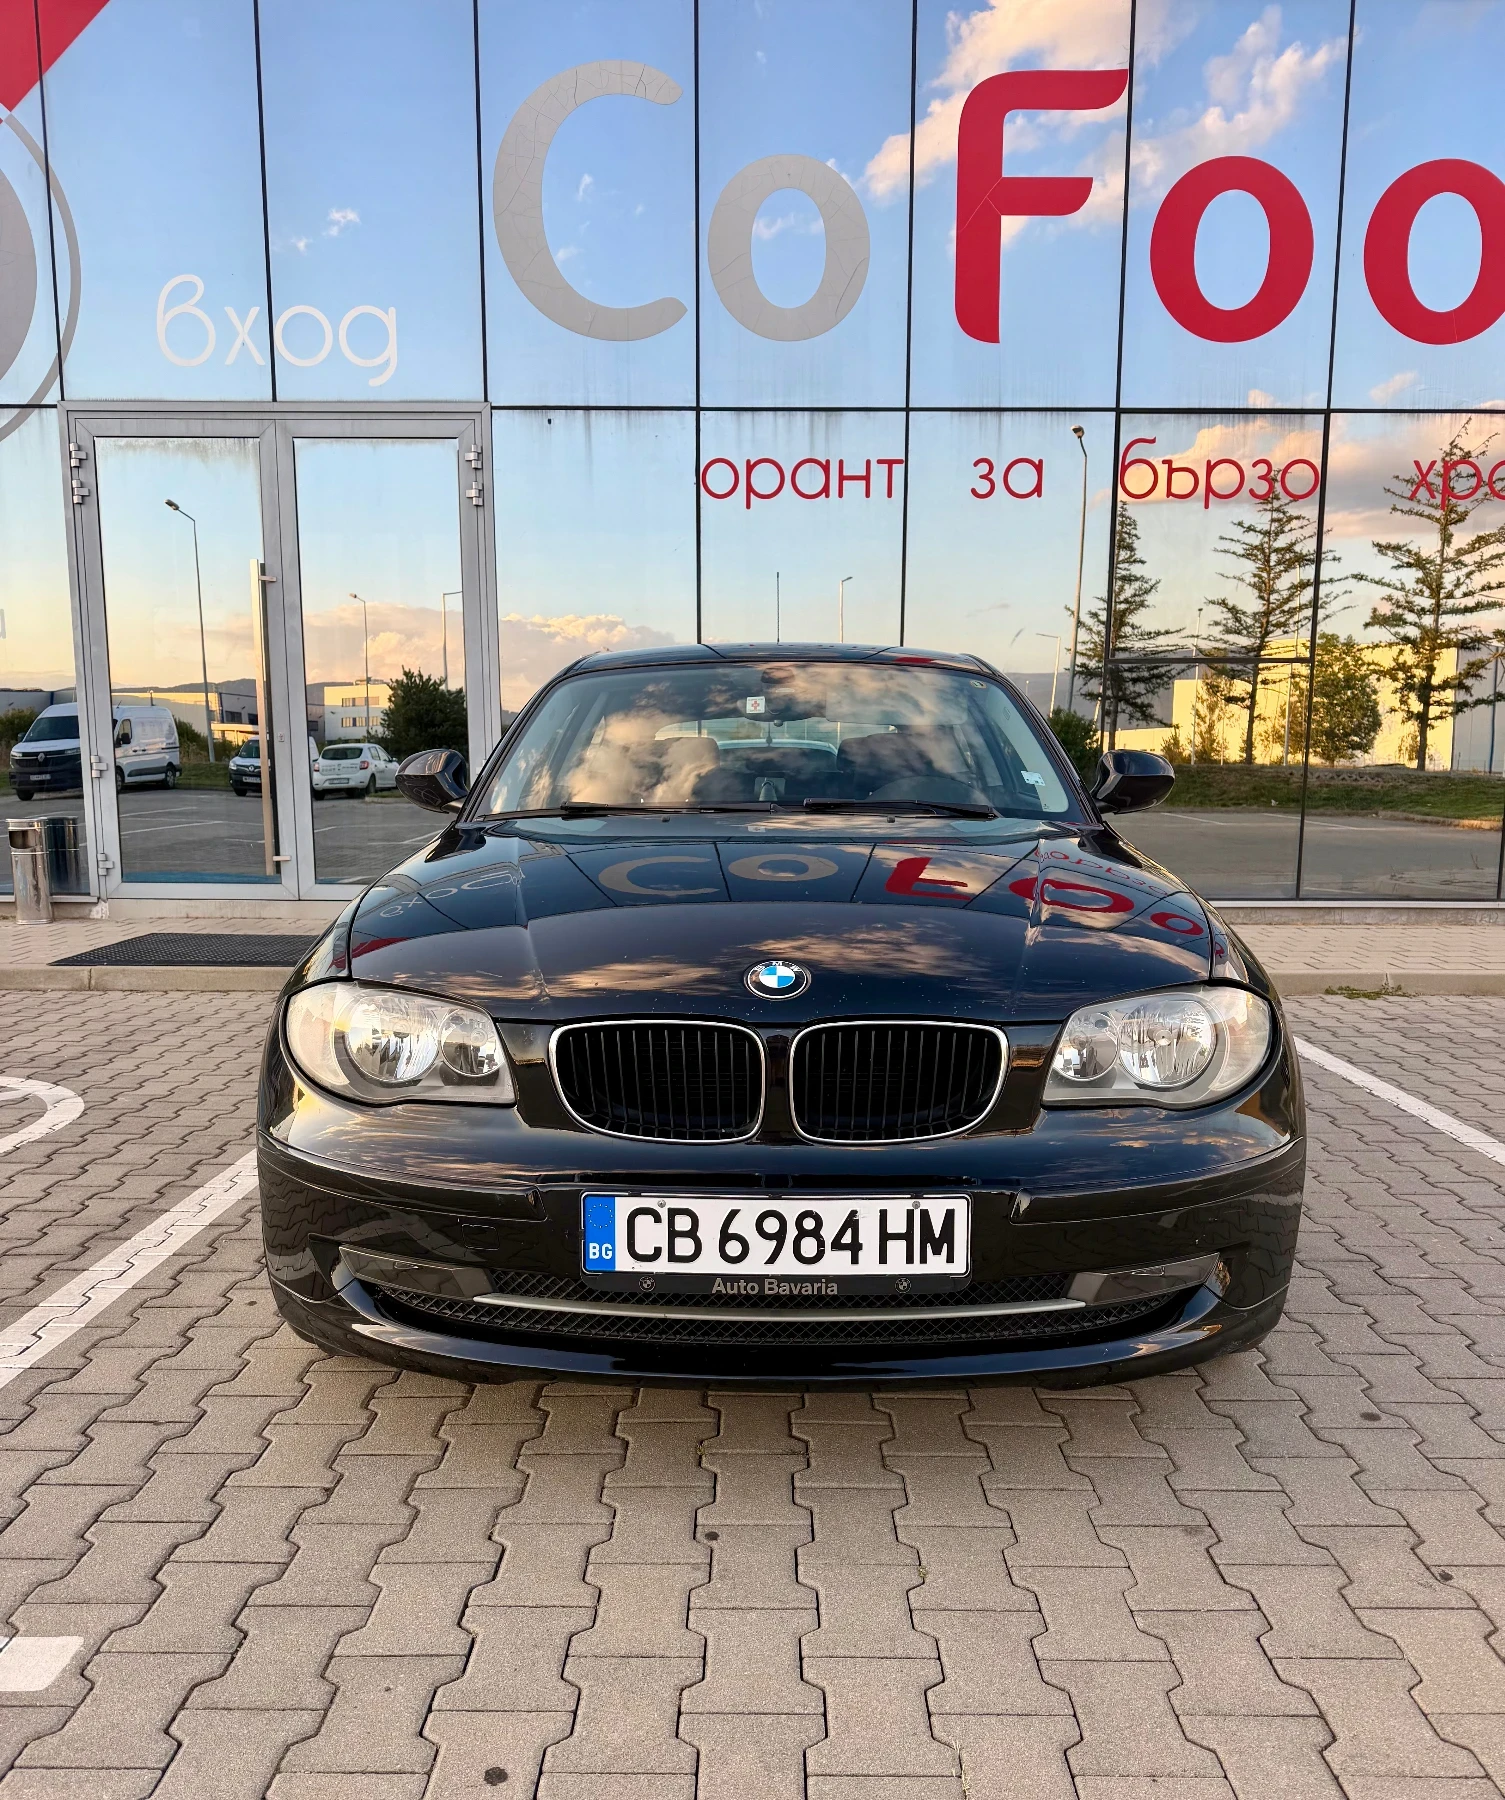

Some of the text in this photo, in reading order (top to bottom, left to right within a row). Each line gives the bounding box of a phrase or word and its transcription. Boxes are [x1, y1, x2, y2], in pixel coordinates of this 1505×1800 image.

[157, 274, 397, 387] вход
[702, 458, 904, 509] орант
[971, 458, 1043, 499] за
[1120, 438, 1320, 510] бързо
[588, 1242, 613, 1260] BG
[626, 1206, 956, 1266] CB 6984 HM
[712, 1277, 839, 1296] Auto Bavaria
